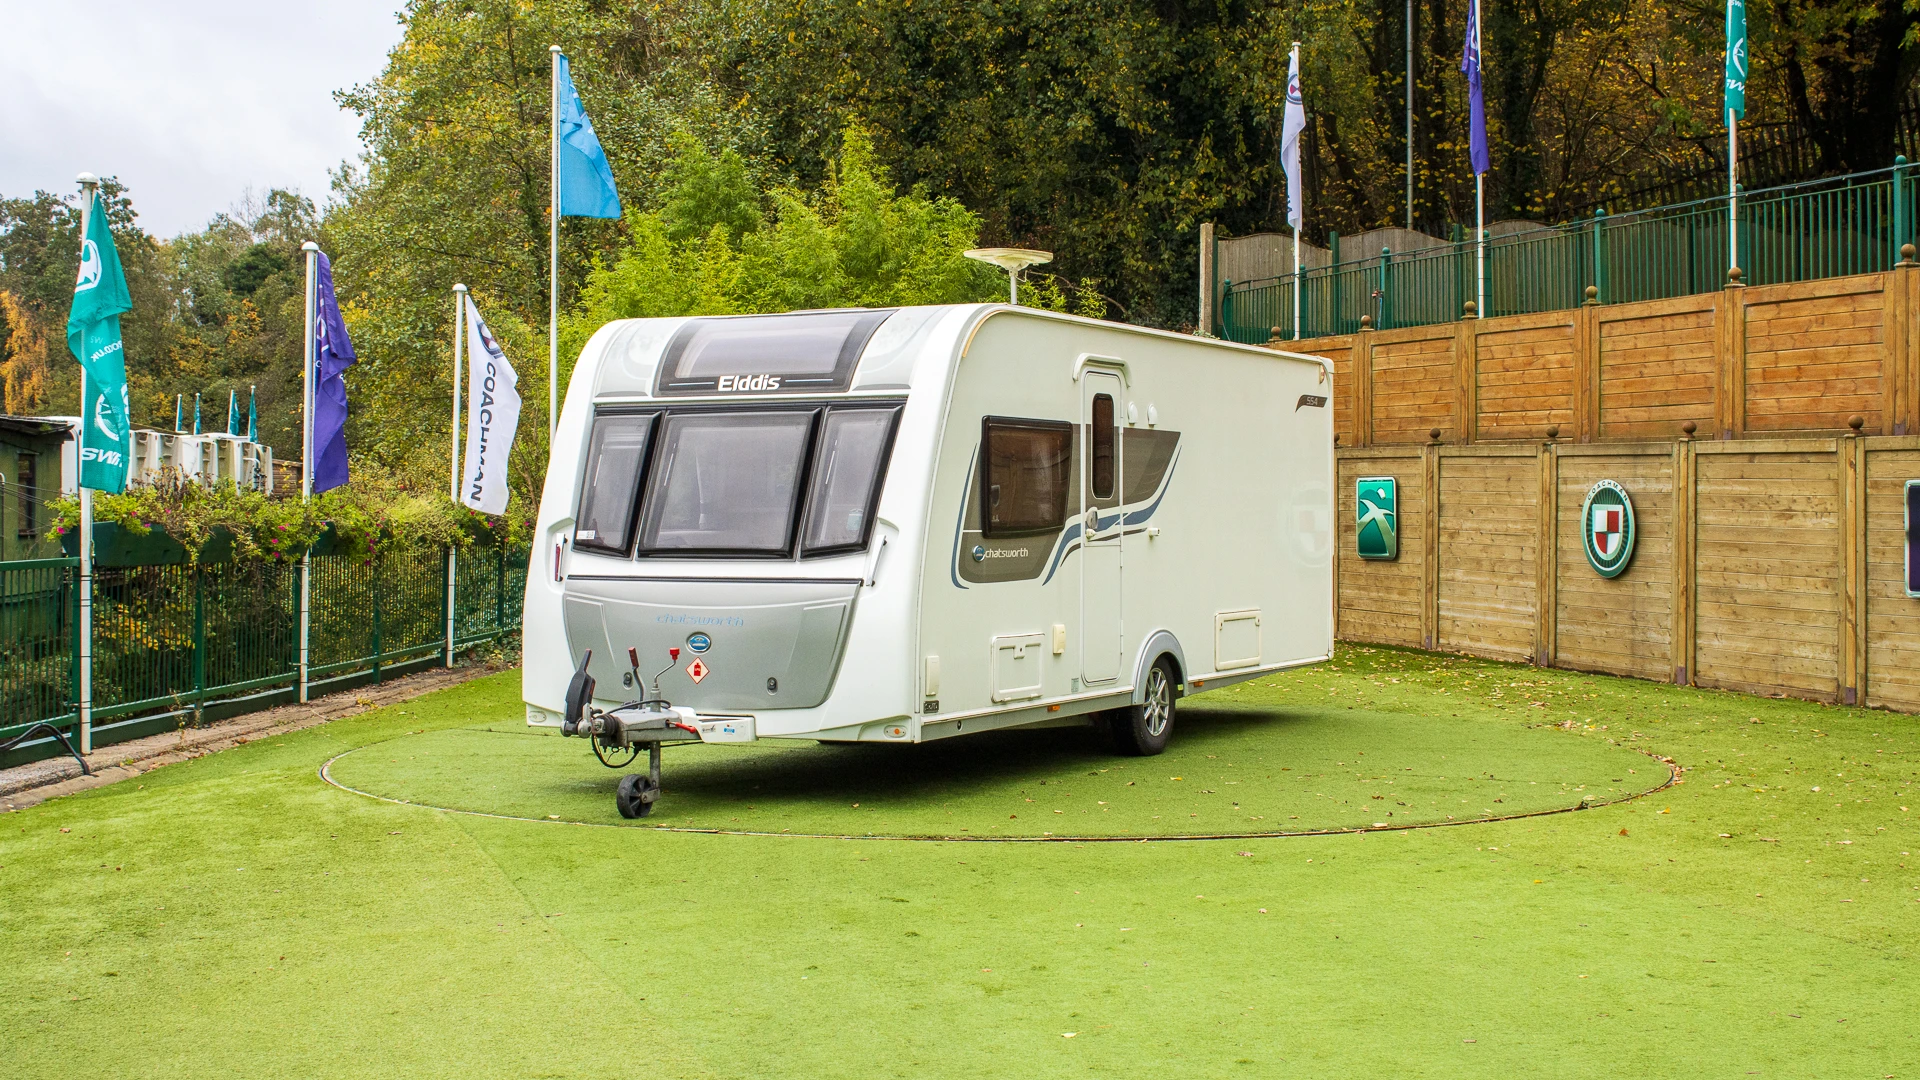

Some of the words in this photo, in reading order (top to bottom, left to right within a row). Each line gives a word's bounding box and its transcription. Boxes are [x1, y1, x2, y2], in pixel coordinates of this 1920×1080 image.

[718, 374, 781, 392] Elddis
[1306, 396, 1318, 406] 554
[1587, 480, 1628, 502] COACHMAN
[984, 547, 1029, 558] chatsworth
[655, 613, 744, 627] chatsworth
